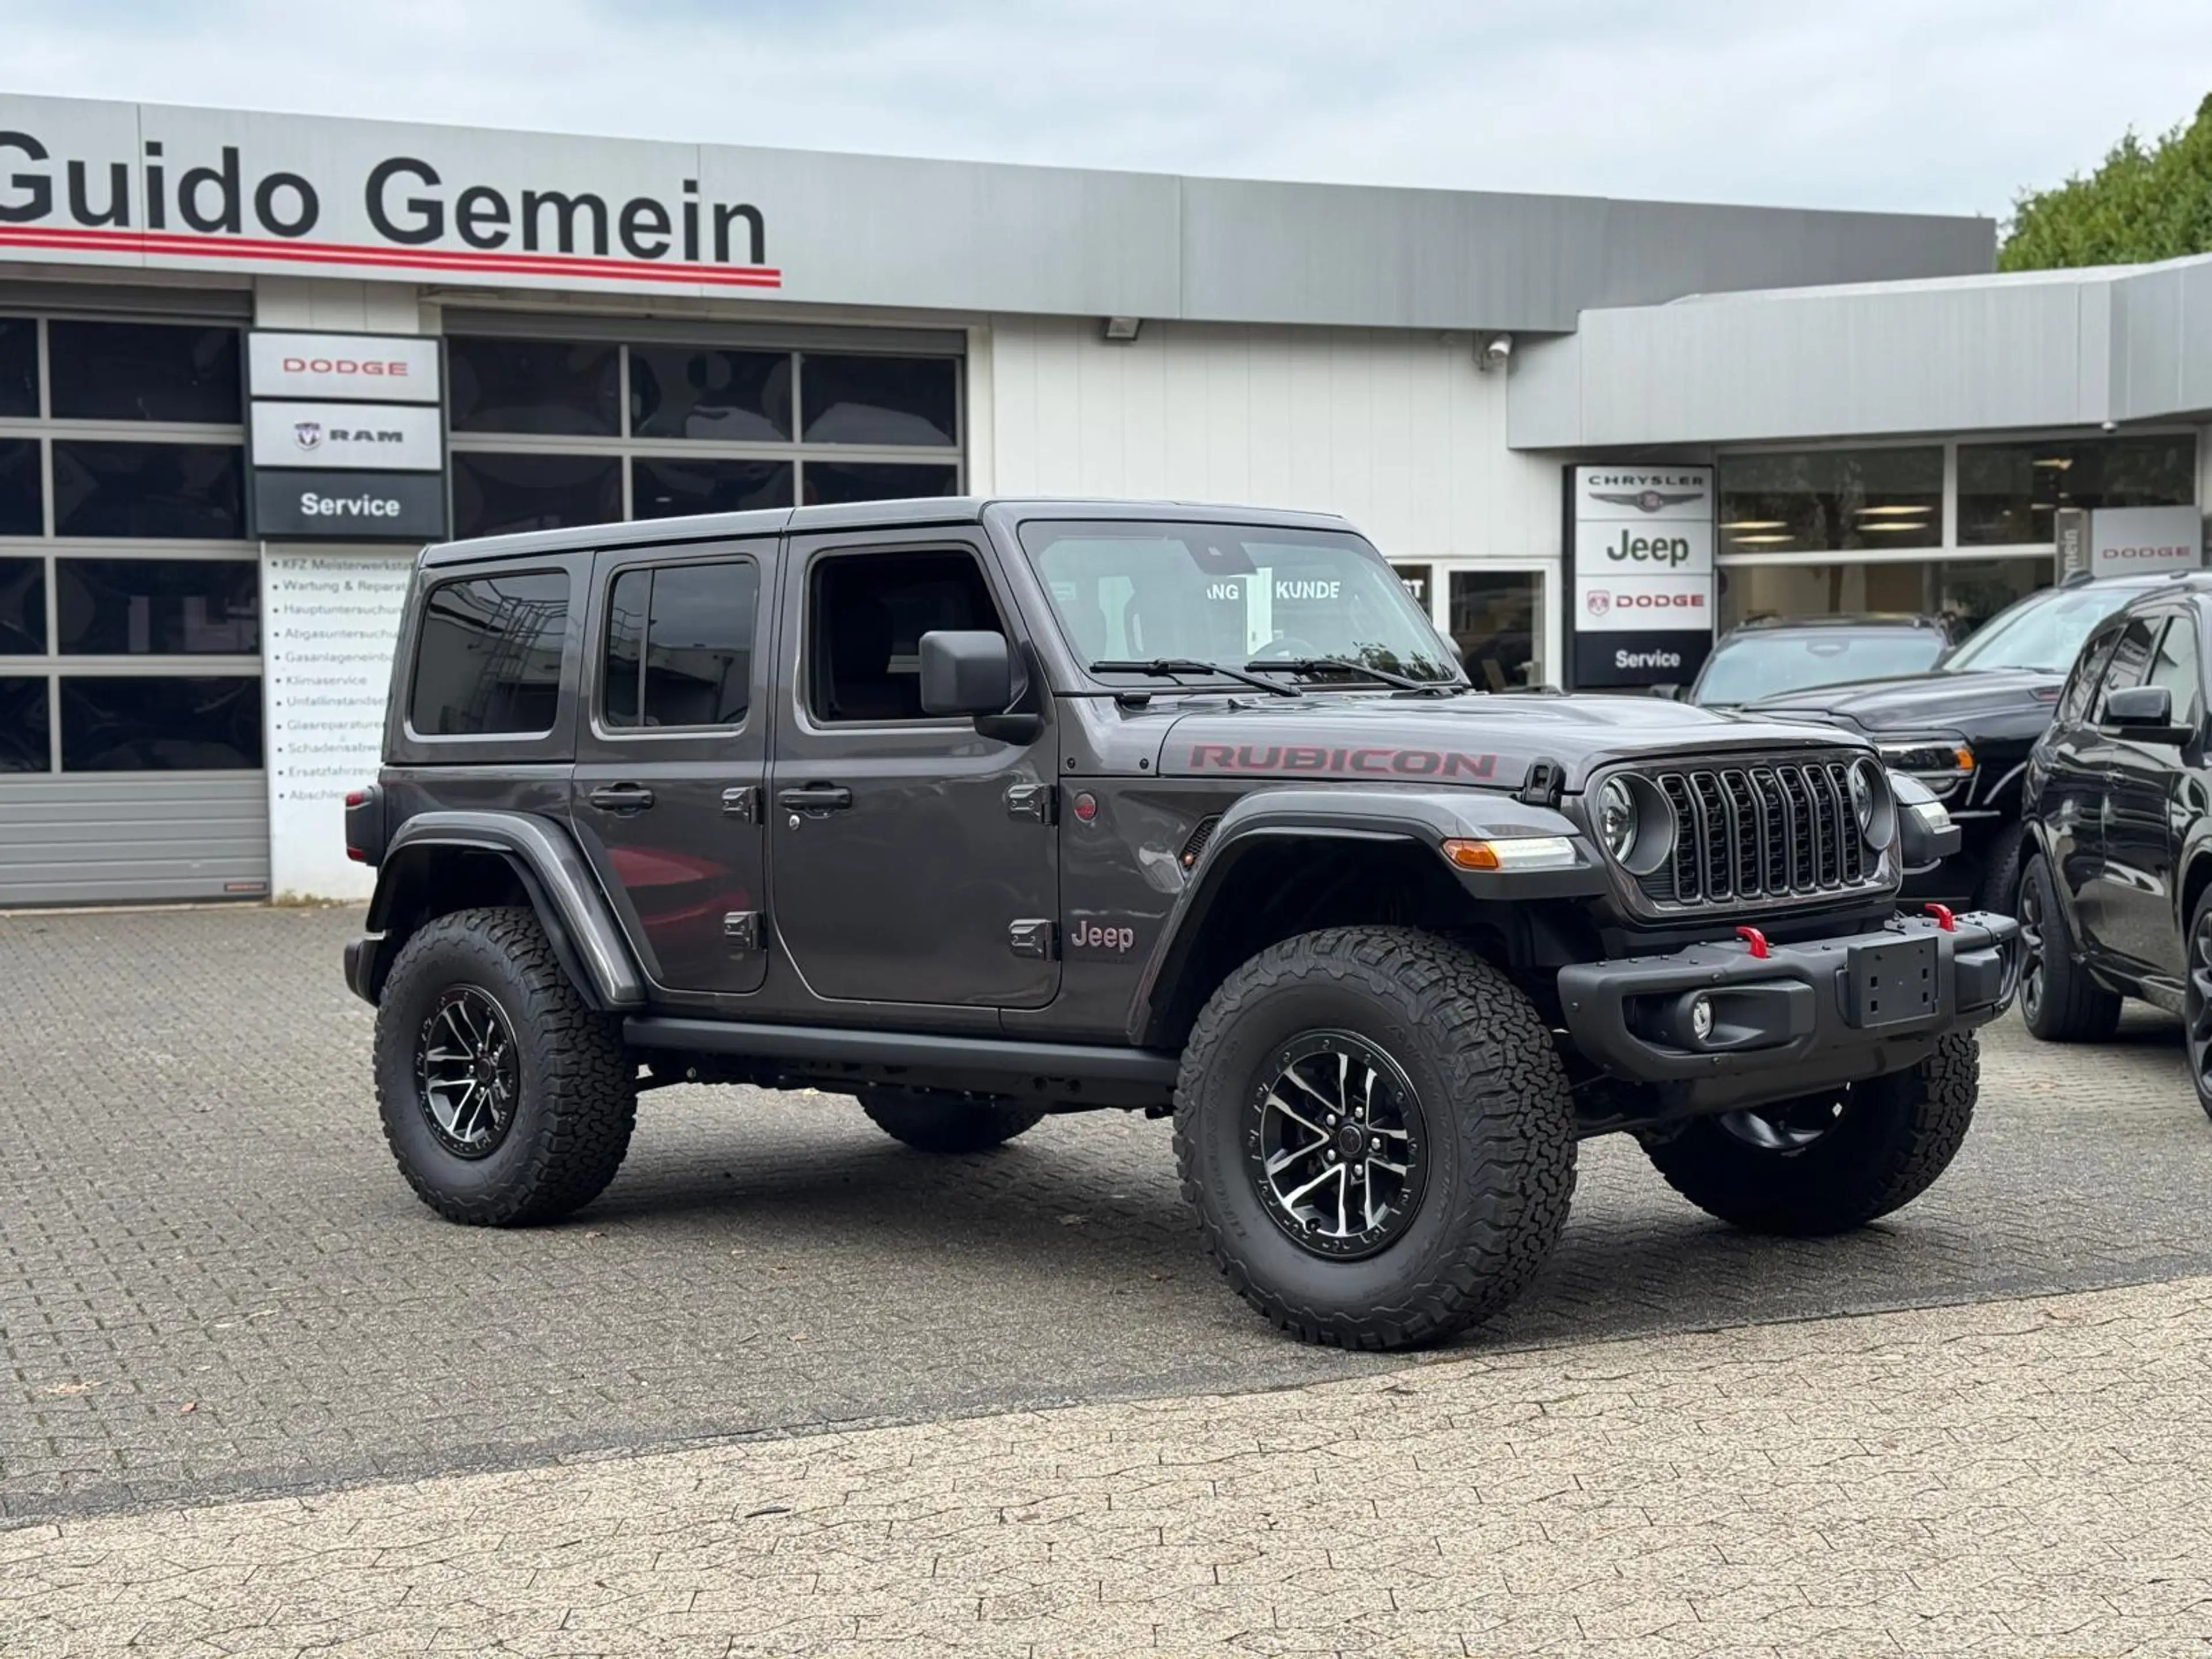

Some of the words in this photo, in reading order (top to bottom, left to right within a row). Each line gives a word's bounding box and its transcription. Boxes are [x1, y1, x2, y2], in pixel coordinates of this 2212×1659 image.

[0, 130, 320, 238] Guido
[365, 157, 766, 265] Gemein
[283, 358, 408, 377] DODGE
[329, 429, 403, 443] RAM
[1588, 475, 1704, 486] CHRYSLER
[301, 492, 401, 517] Service
[1606, 528, 1690, 568] Jeep
[2103, 546, 2190, 559] DODGE
[282, 580, 339, 593] Wartung
[344, 581, 353, 592] &
[1206, 584, 1239, 600] NG
[1275, 580, 1341, 599] KUNDE
[1616, 594, 1705, 608] DODGE
[1615, 649, 1681, 668] Service
[286, 675, 368, 686] Klimaservice
[1188, 744, 1498, 778] RUBICON
[1071, 920, 1134, 953] Jeep
